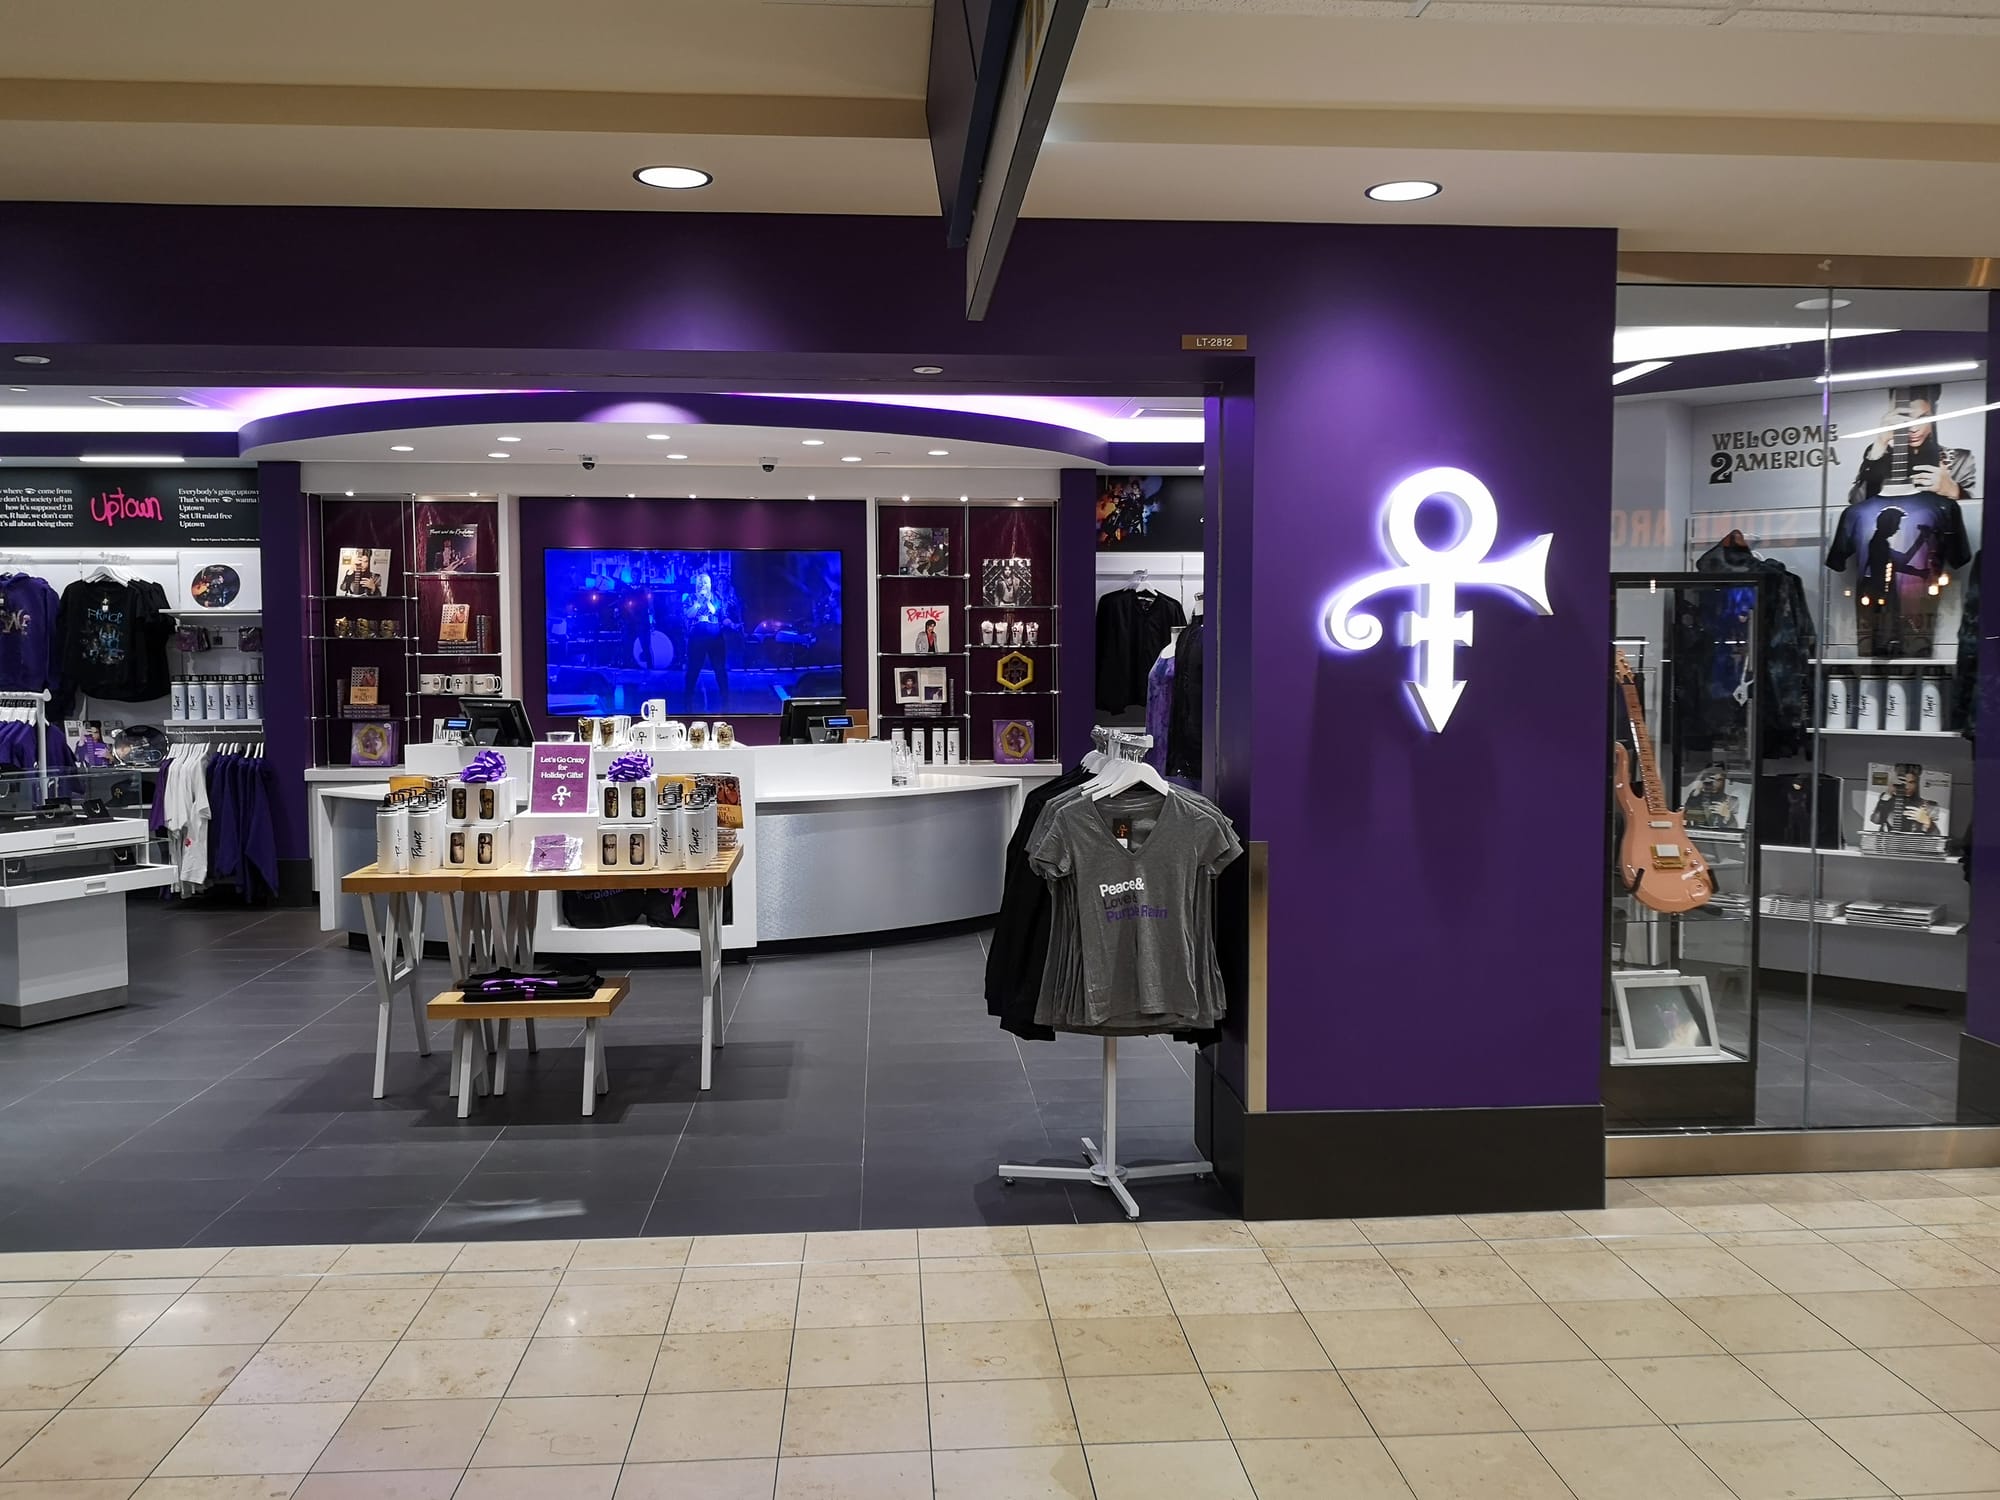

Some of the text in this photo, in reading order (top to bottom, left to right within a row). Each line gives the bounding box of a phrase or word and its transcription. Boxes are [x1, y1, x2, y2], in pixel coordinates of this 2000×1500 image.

[1196, 338, 1233, 347] LT-2812
[1712, 424, 1838, 450] WELCOME
[1709, 447, 1841, 484] 2 AMERICA
[90, 487, 163, 526] Uptown
[906, 607, 944, 622] PRINCE
[557, 763, 568, 771] for
[566, 756, 586, 764] Crazy
[540, 771, 584, 780] Holiday Gifts!
[1099, 877, 1145, 898] Peace&
